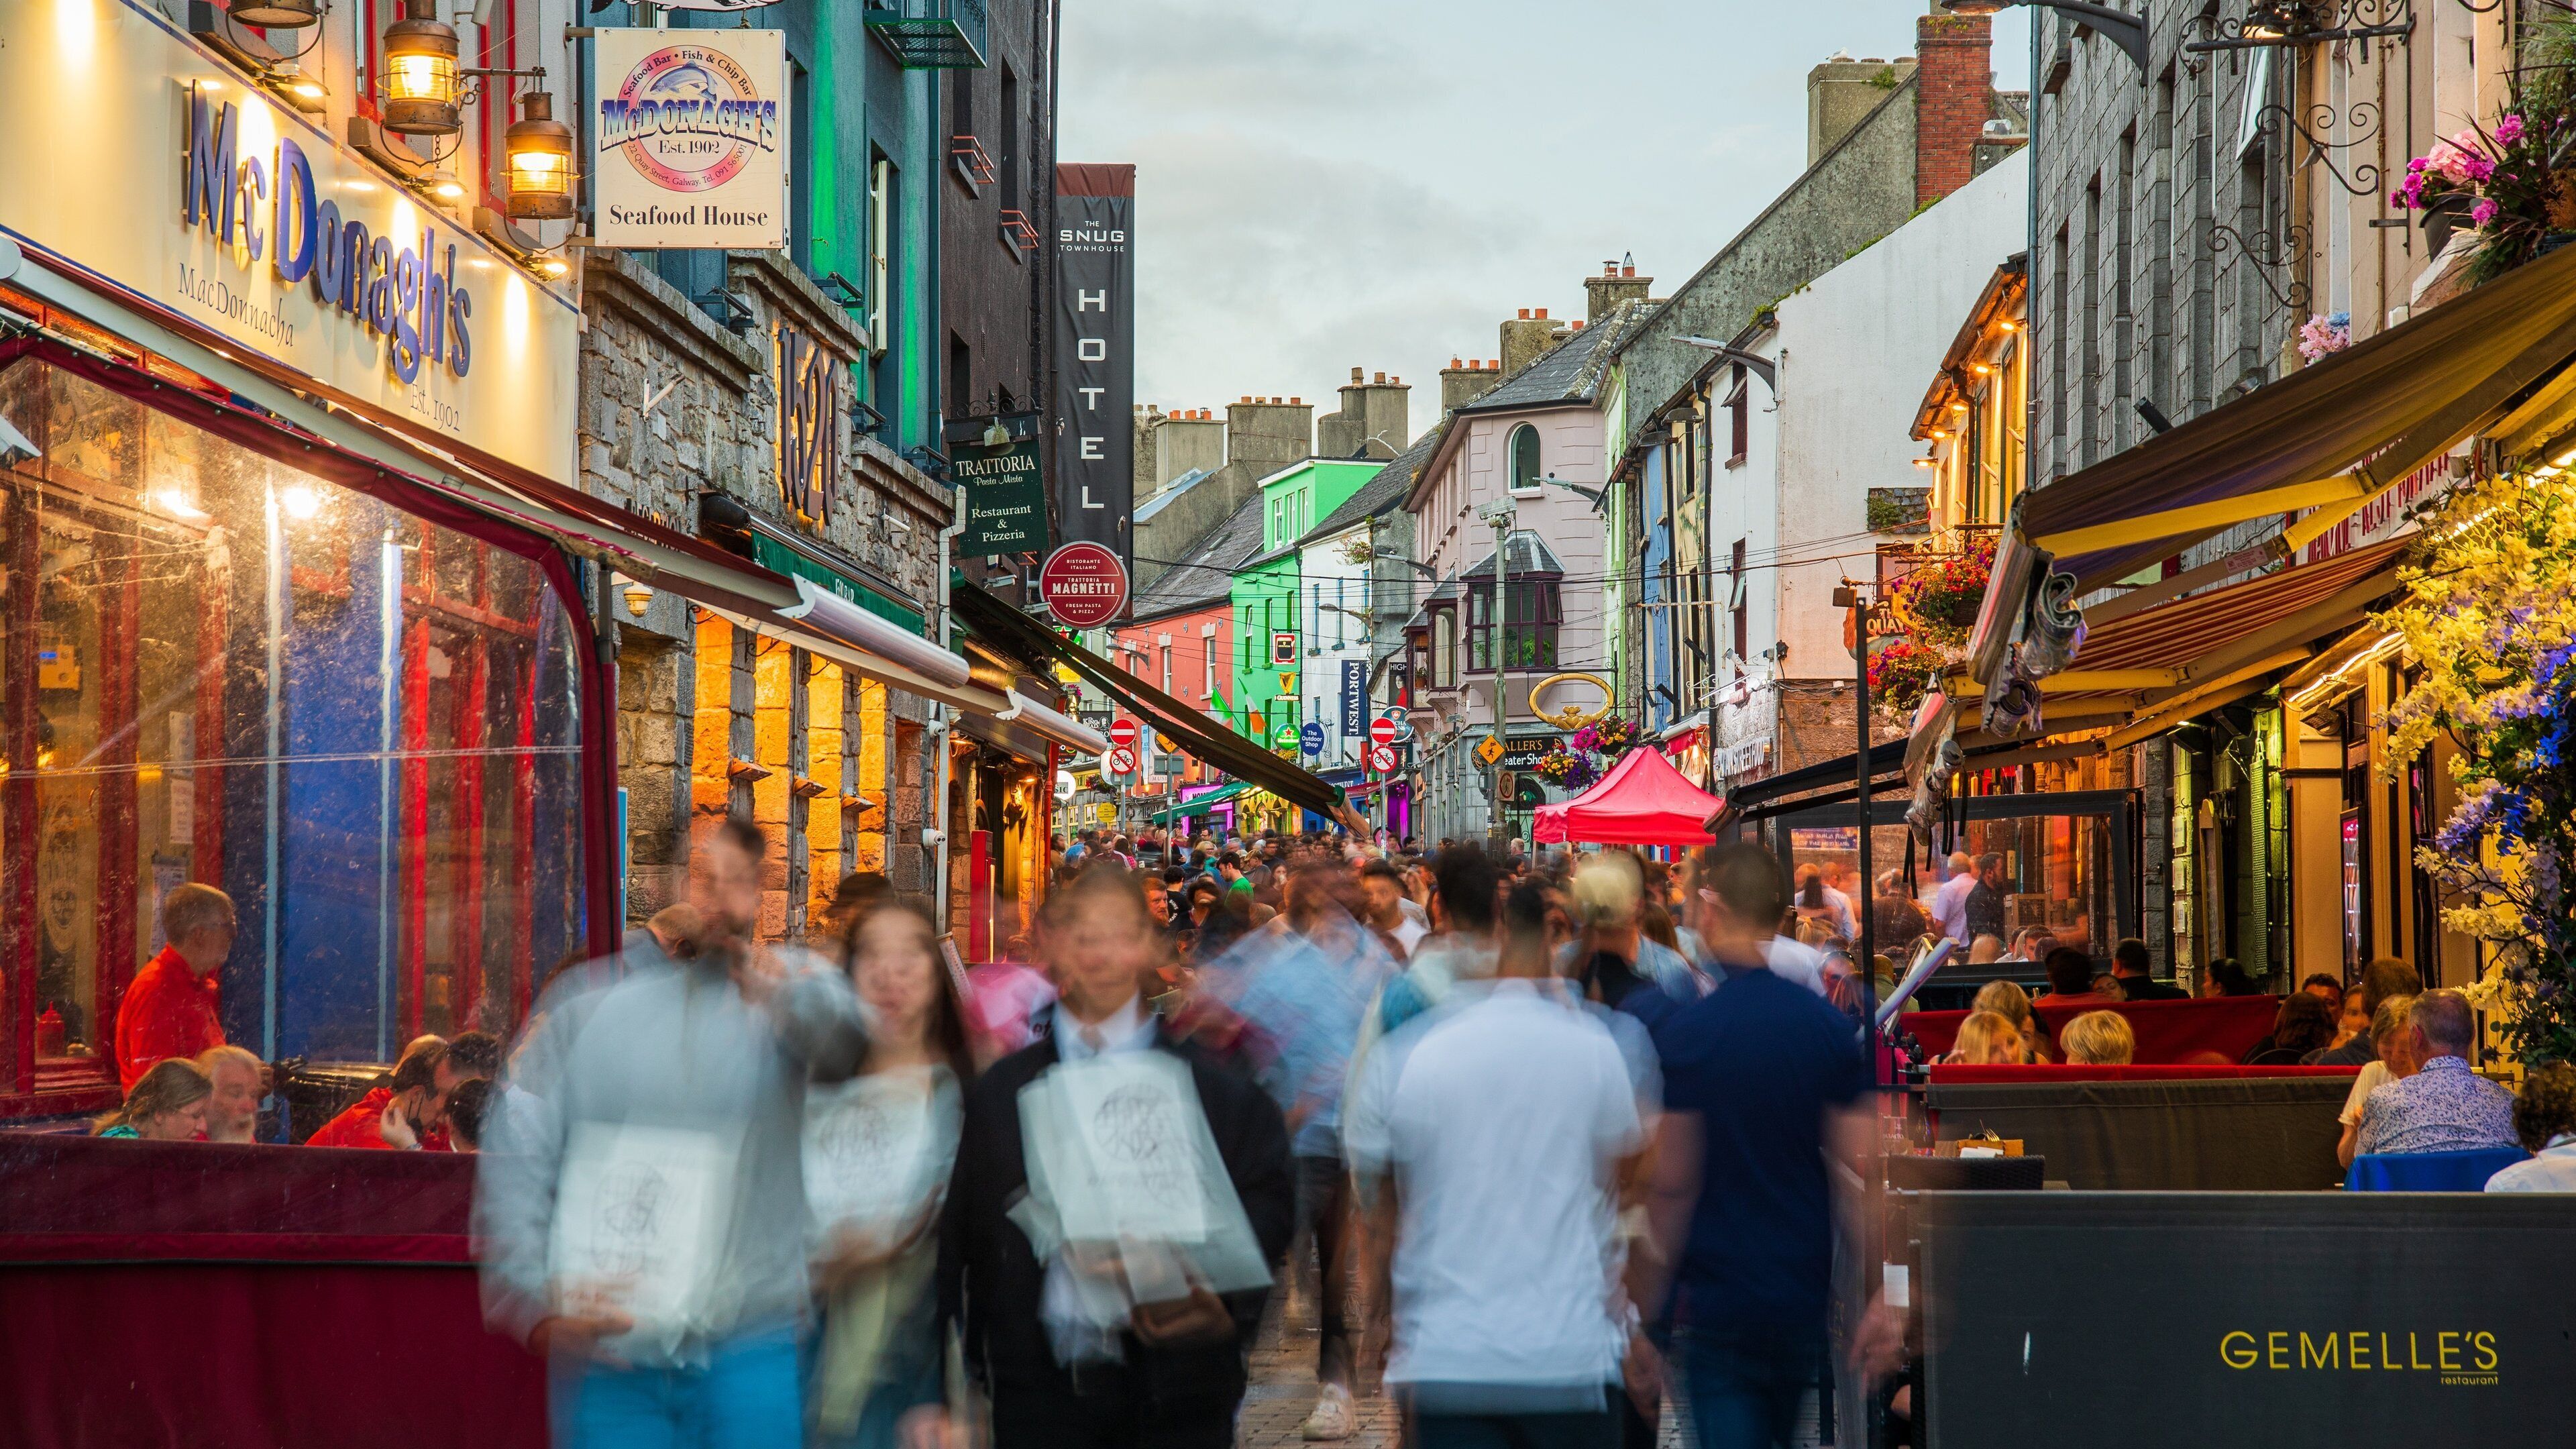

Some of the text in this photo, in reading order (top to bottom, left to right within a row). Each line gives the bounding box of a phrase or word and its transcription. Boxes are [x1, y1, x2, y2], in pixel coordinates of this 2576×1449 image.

[623, 50, 752, 98] Seafood Bar Fish & Chip Bar
[659, 140, 720, 154] Est. 1902
[629, 144, 747, 186] 22 Quay Street, Galway. Tel. 091 565001
[610, 204, 768, 227] Seafood House
[1060, 229, 1124, 242] SNUG
[178, 262, 295, 348] MacDonnacha
[1078, 289, 1106, 508] HOTEL
[411, 383, 460, 432] Est. 1902
[956, 455, 1036, 476] TRATTORIA
[973, 474, 1023, 486] Pasta Mista
[971, 504, 1032, 519] Restaurant
[997, 519, 1008, 529] &
[982, 529, 1025, 542] Pizzeria
[1053, 583, 1115, 594] MAGNETTI
[1879, 608, 1892, 619] TH
[1866, 618, 1904, 637] QUAY
[1505, 740, 1542, 751] ALLER'S
[1505, 753, 1543, 765] eater Sho
[2220, 1331, 2498, 1370] GEMELLE'S
[2441, 1375, 2498, 1385] restaurant
